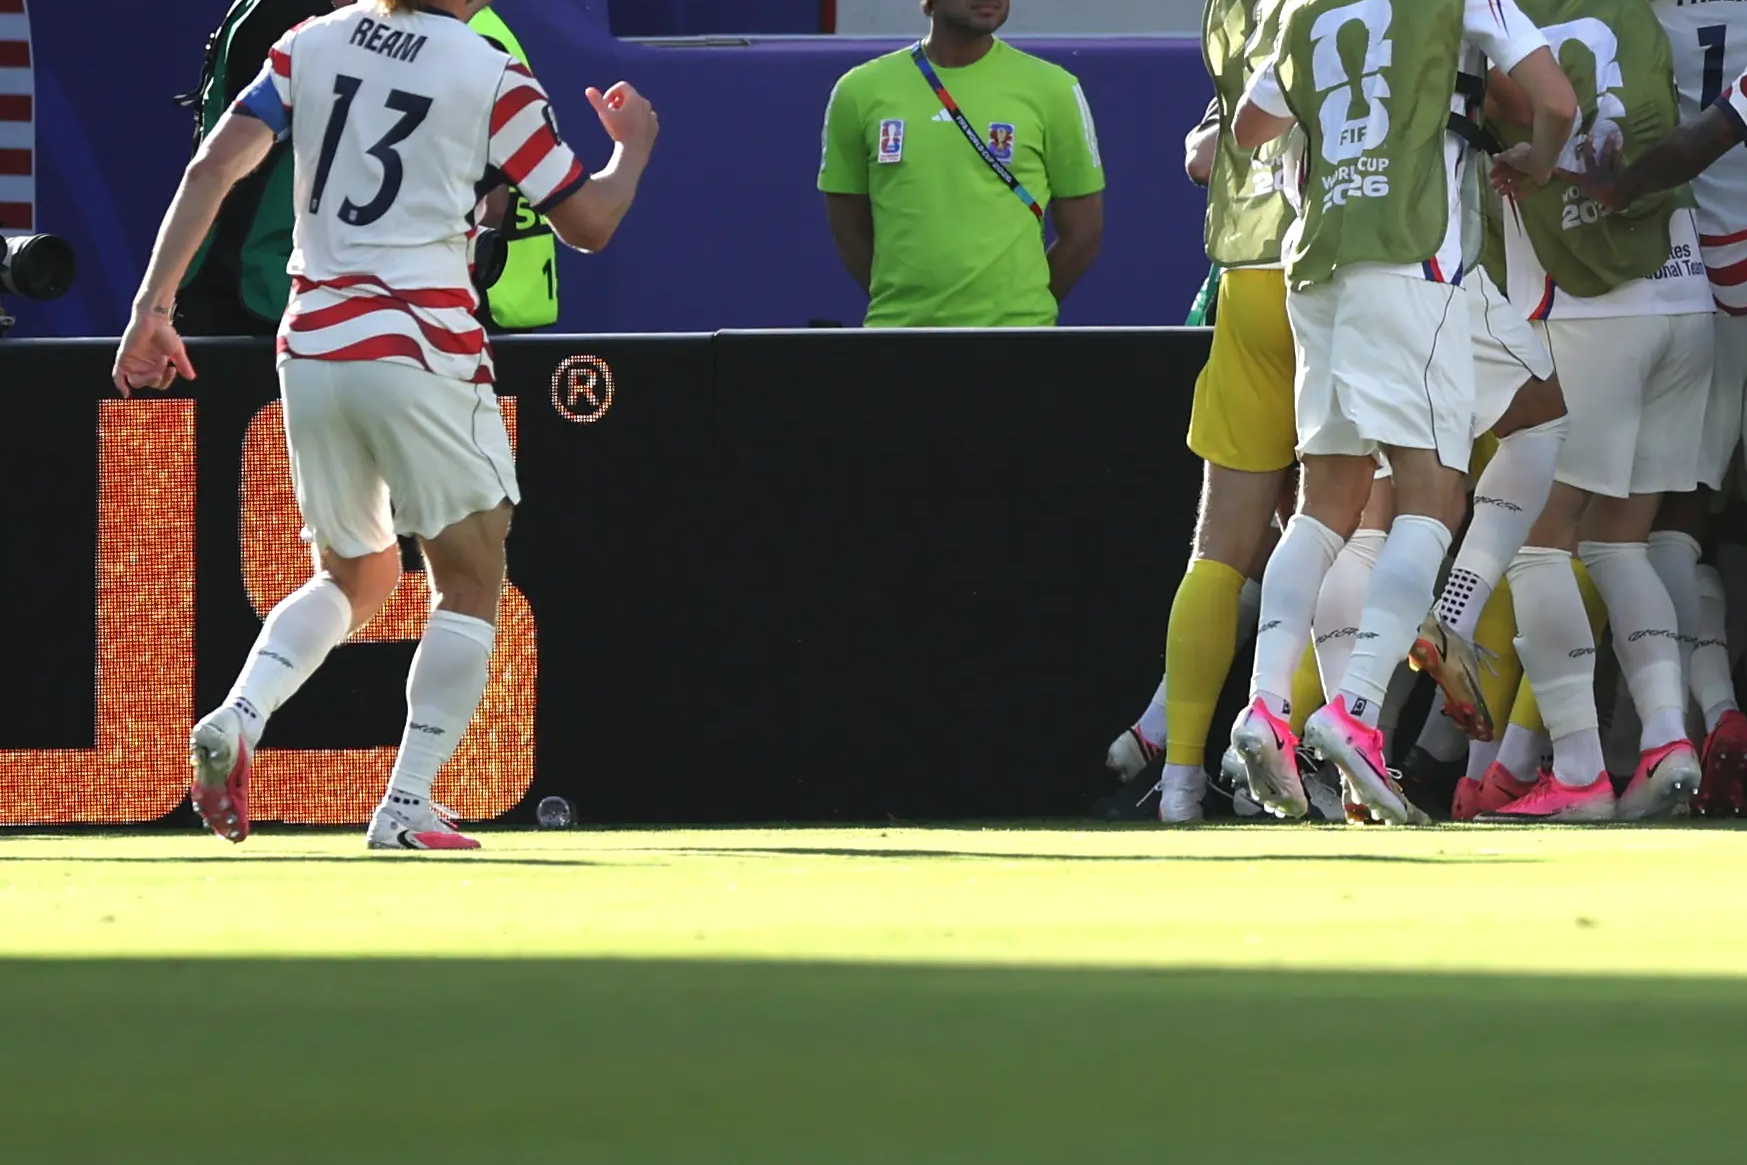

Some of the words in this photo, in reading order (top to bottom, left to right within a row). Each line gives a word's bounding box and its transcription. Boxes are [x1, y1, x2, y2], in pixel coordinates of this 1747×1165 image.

[348, 17, 428, 63] REAM
[309, 73, 433, 226] 13
[956, 115, 968, 131] FIFA
[966, 130, 985, 152] WORLD
[981, 149, 994, 165] CUP
[1357, 156, 1389, 172] CUP
